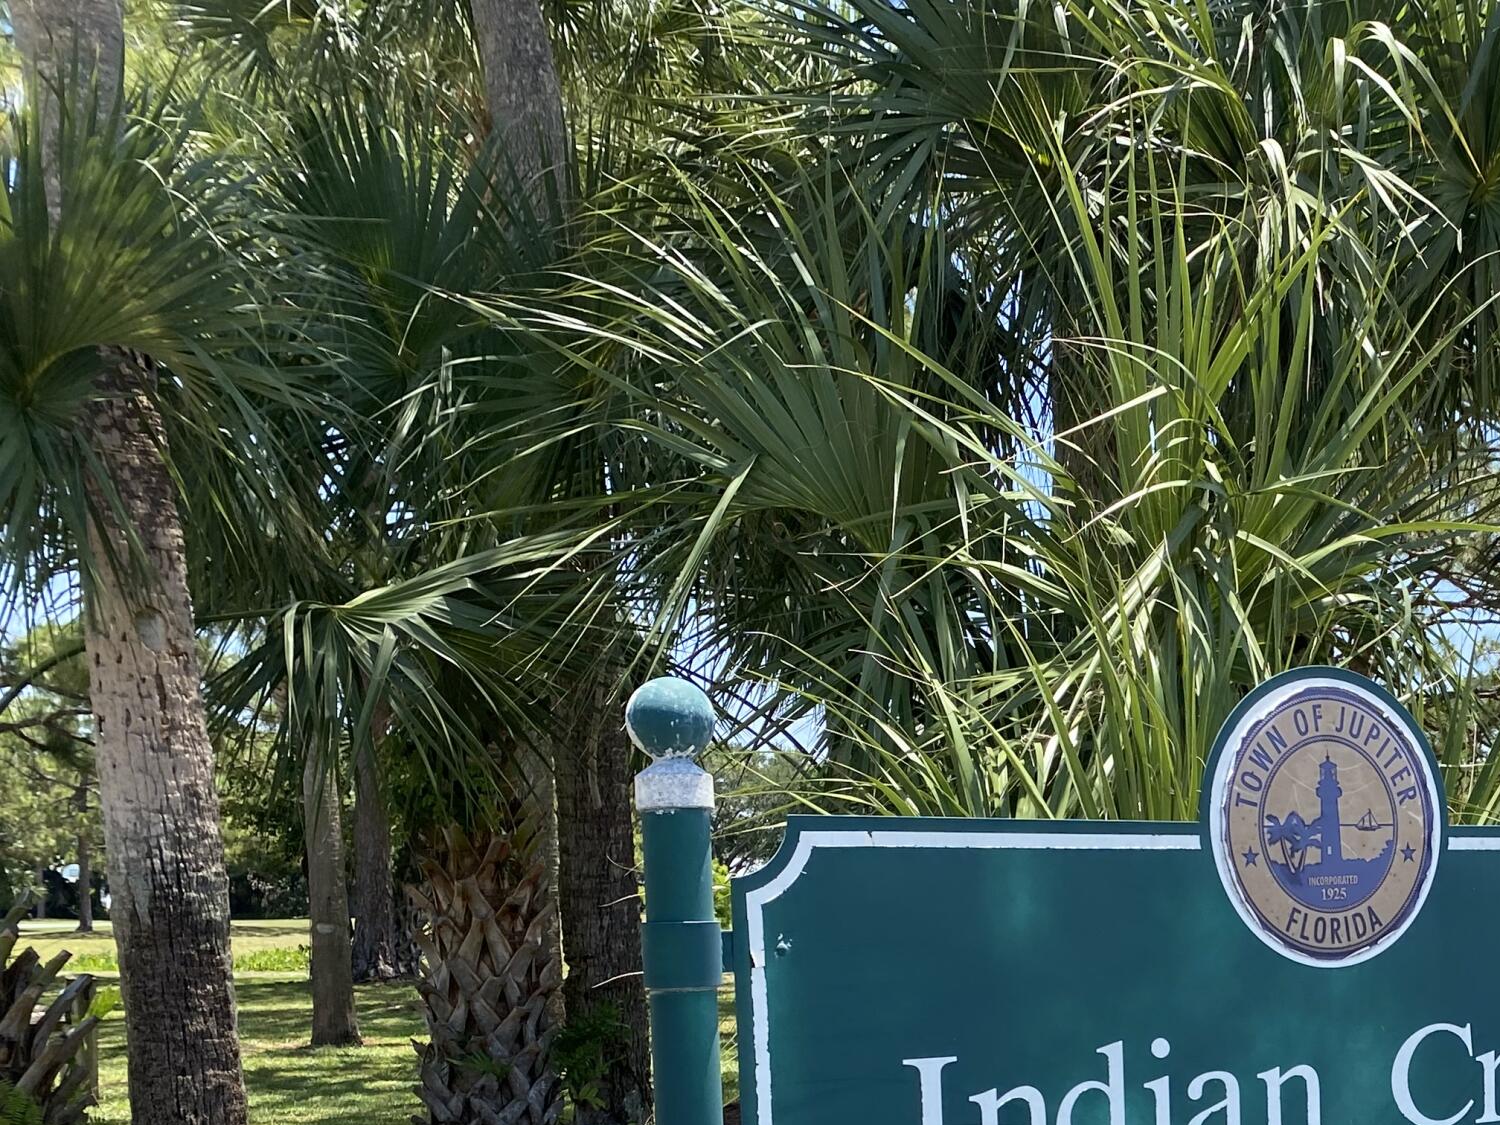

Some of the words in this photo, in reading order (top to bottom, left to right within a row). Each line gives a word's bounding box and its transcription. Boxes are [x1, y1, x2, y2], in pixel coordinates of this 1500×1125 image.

[1235, 724, 1288, 808] TOWN
[1293, 703, 1323, 736] OF
[1334, 705, 1417, 805] JUPITER
[1308, 874, 1359, 887] INCORPORATED
[1320, 887, 1348, 901] 1925
[1284, 904, 1384, 945] FLORIDA
